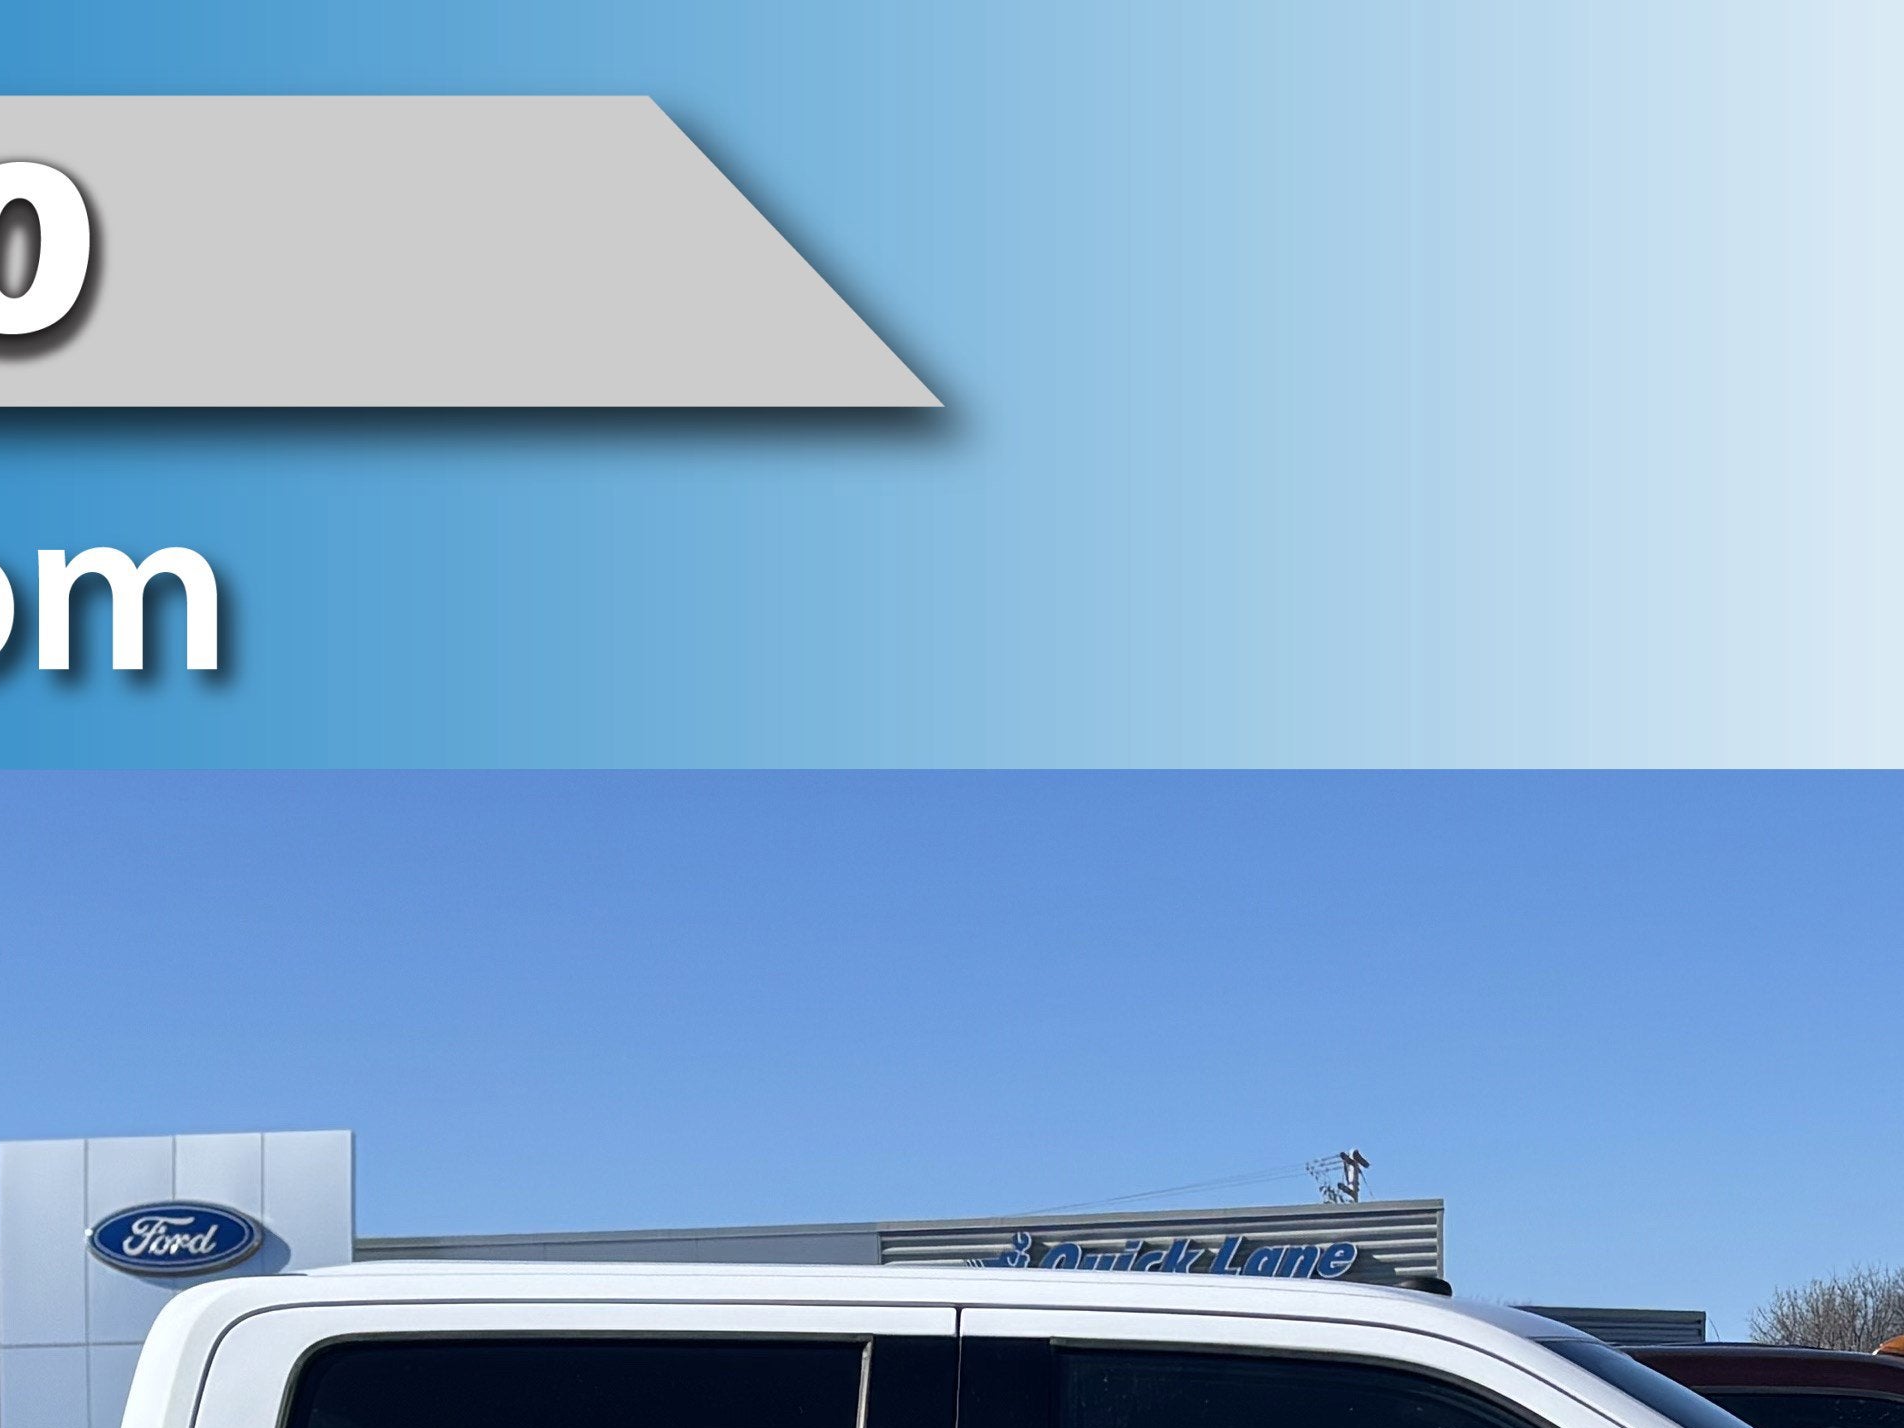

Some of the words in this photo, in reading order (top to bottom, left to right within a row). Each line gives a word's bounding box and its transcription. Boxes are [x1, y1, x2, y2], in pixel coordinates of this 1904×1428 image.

[122, 1216, 219, 1257] Ford
[1038, 1238, 1205, 1274] Quick
[1210, 1235, 1359, 1279] Lane
